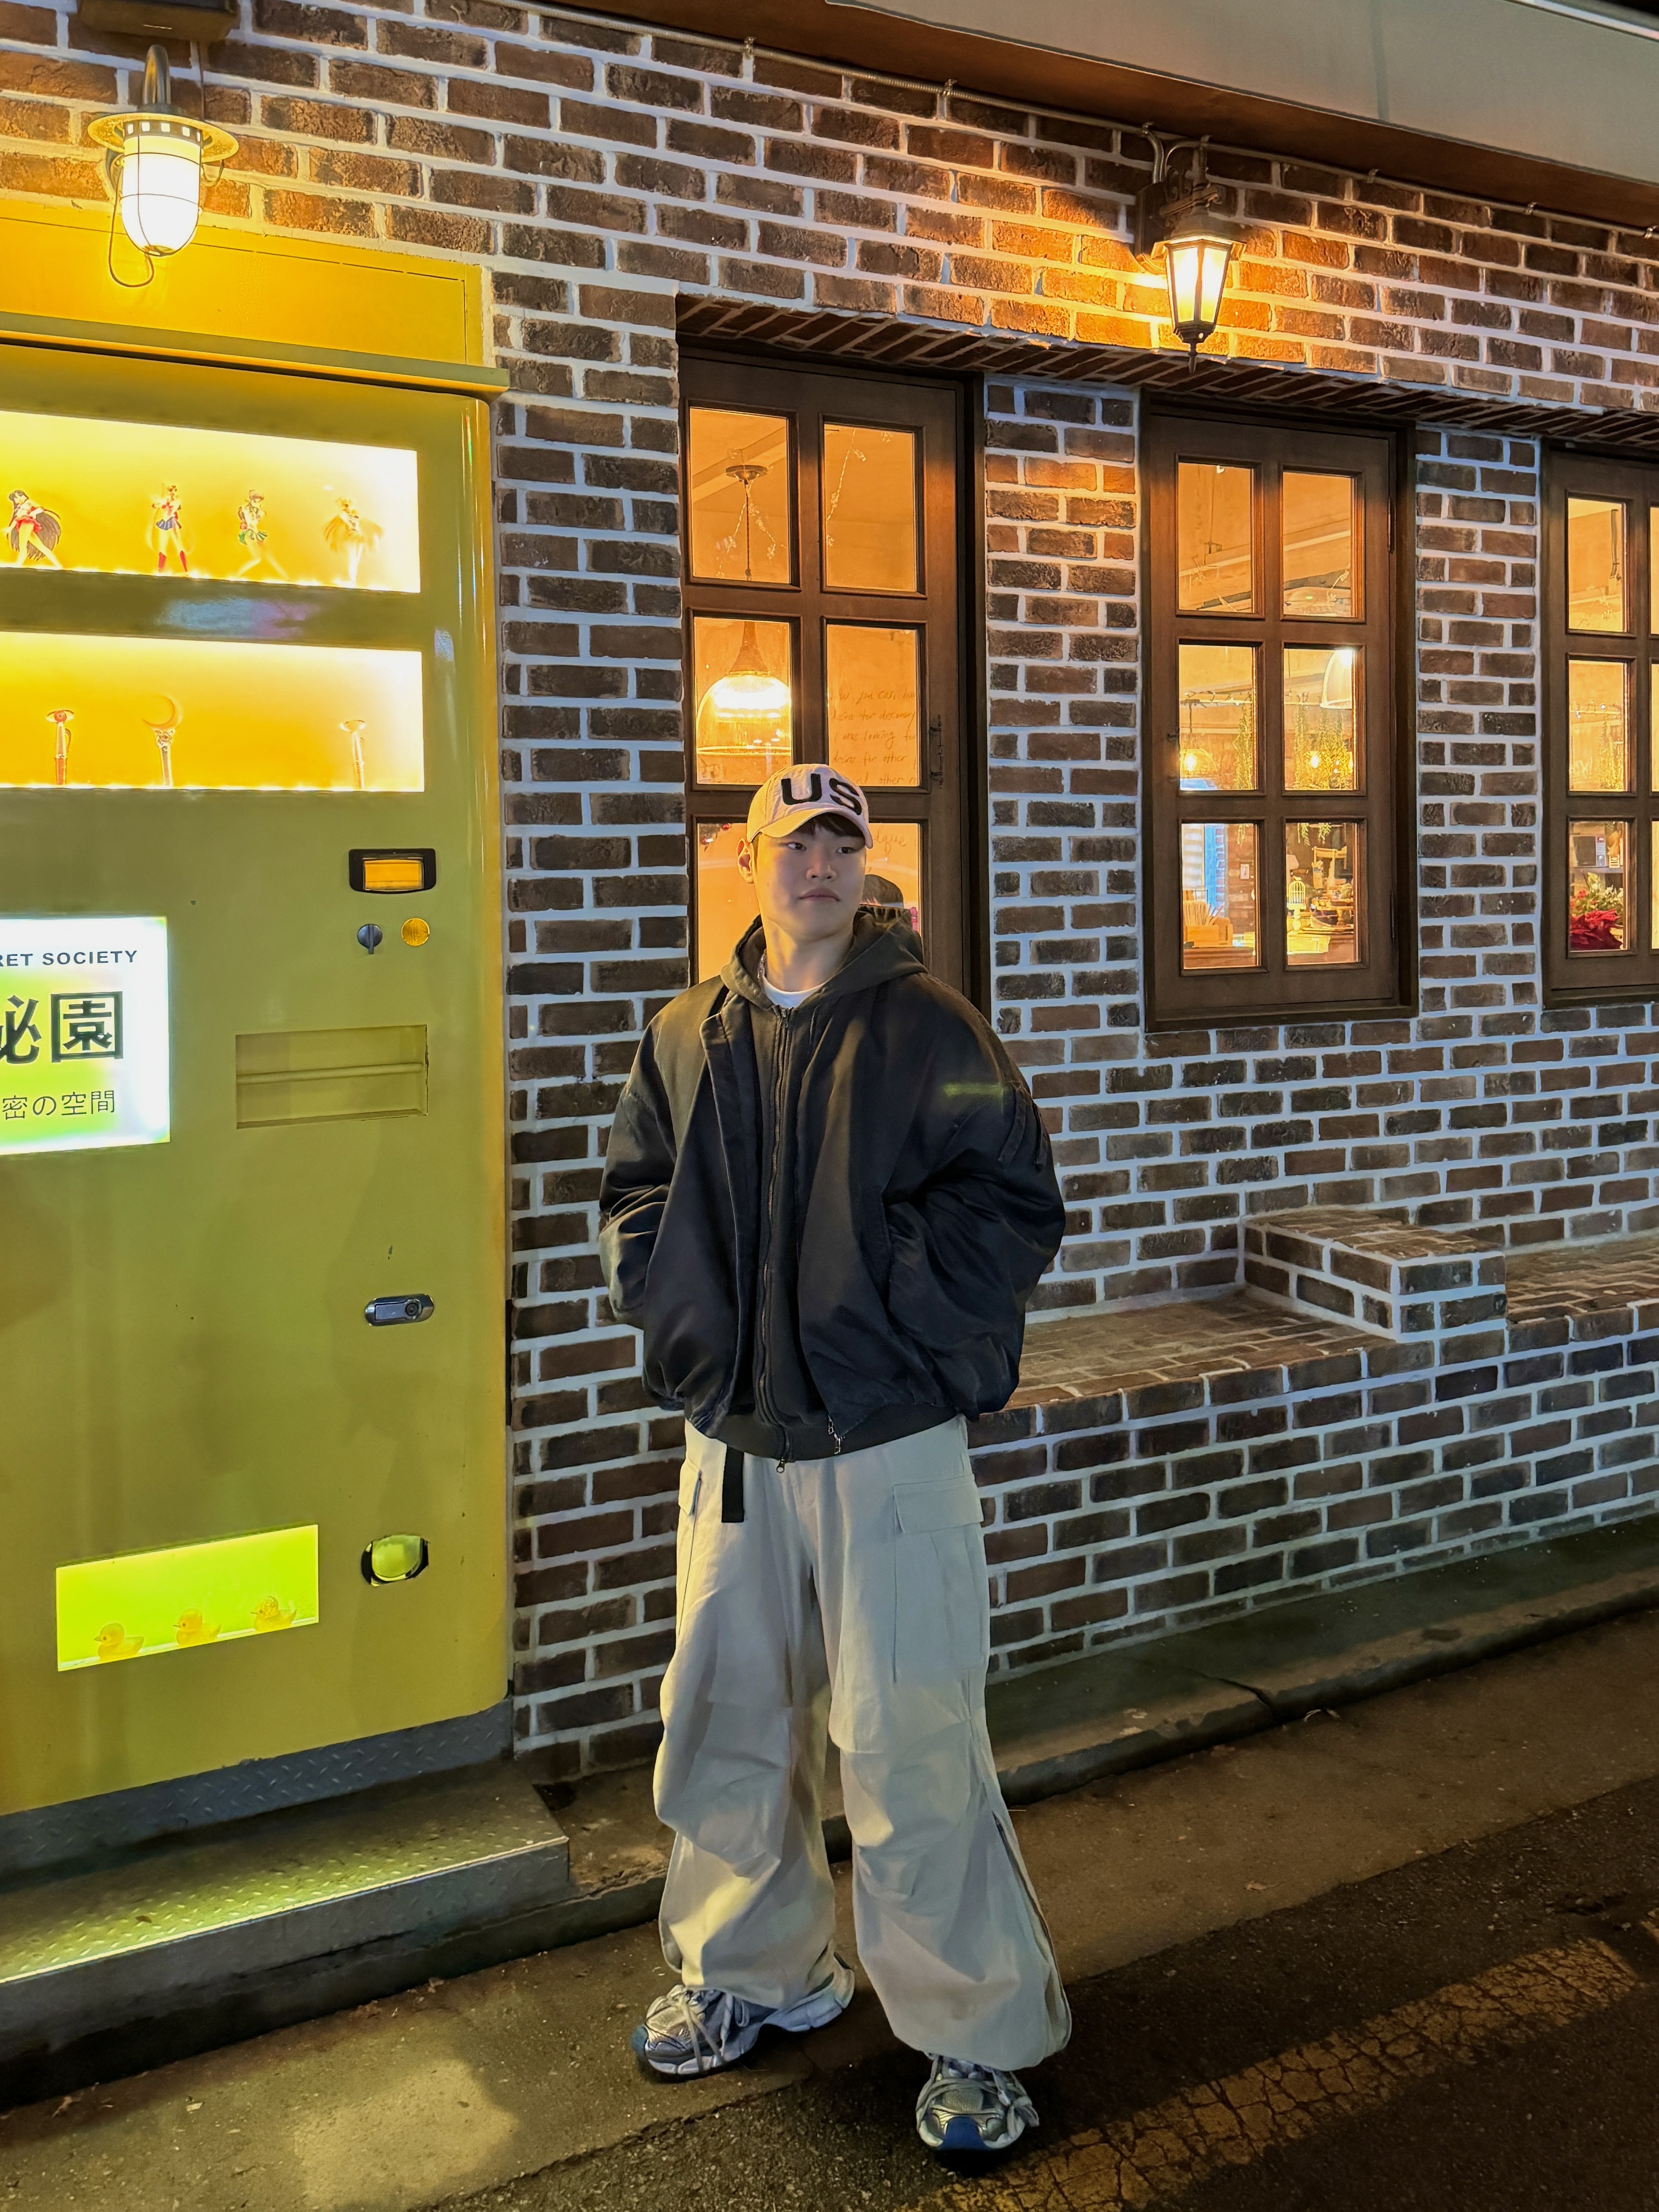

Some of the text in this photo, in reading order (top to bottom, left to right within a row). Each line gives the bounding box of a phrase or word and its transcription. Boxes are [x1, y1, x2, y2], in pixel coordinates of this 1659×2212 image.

[781, 773, 862, 815] US
[43, 950, 137, 965] SOCIETY
[2, 1090, 115, 1120] 密の空間
